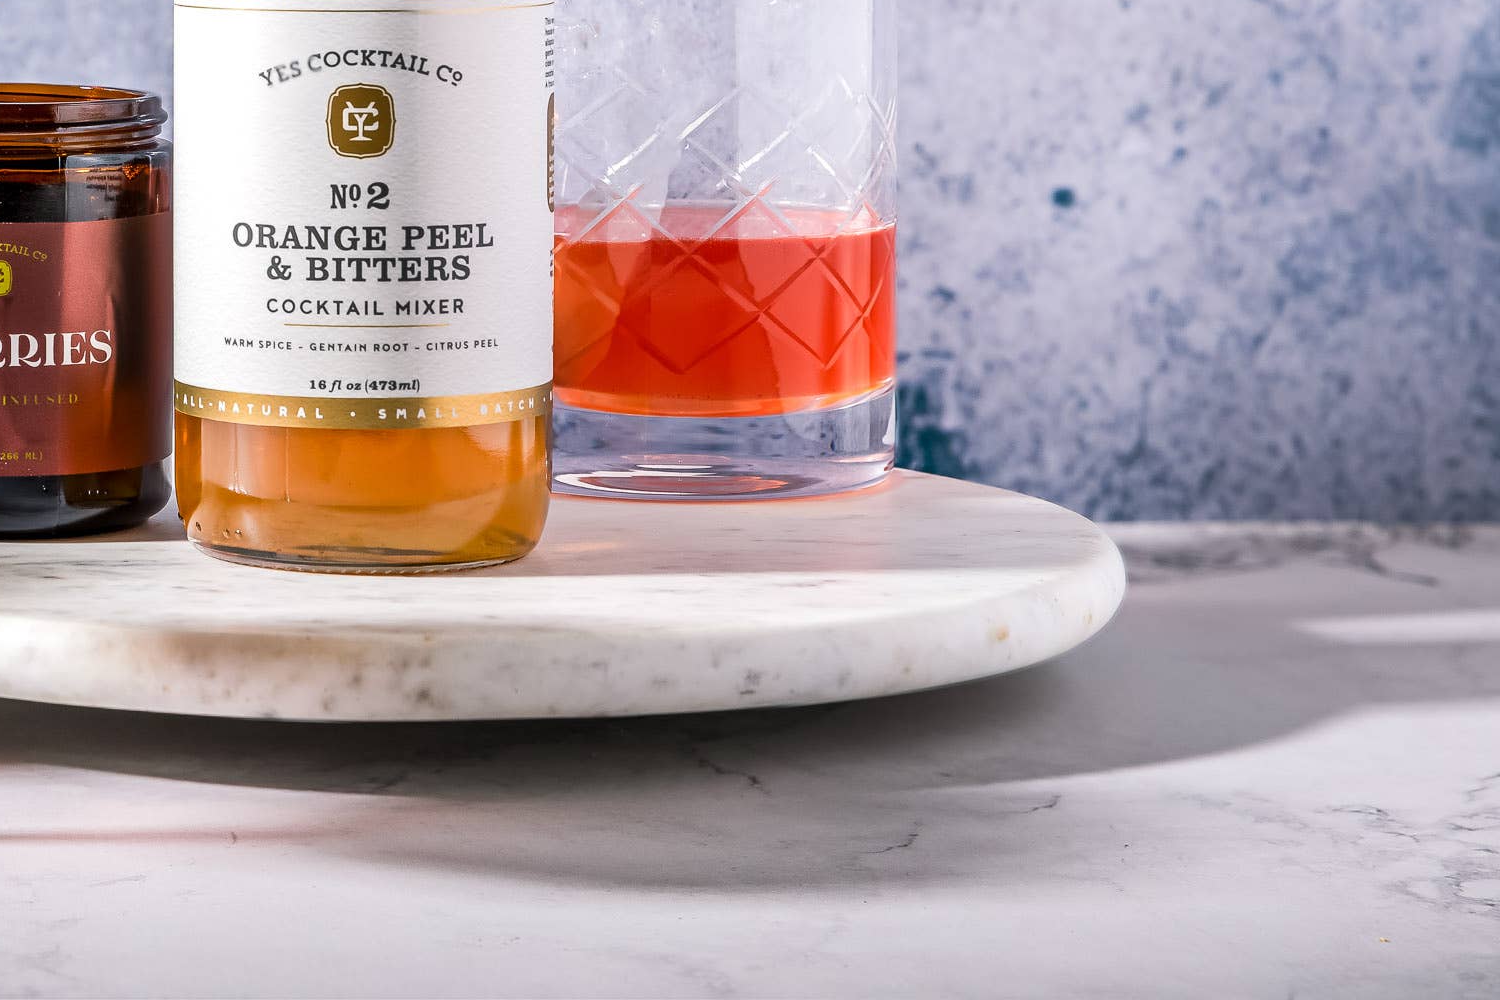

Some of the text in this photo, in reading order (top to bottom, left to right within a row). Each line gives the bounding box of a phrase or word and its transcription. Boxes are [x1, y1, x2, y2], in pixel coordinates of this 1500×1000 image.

[259, 61, 302, 86] YES
[307, 50, 430, 76] COCKTAIL
[366, 181, 390, 210] 2
[232, 222, 494, 251] ORANGE PEEL
[266, 254, 471, 282] & BITTERS
[266, 298, 464, 316] COCKTAIL MIXER
[224, 337, 499, 352] WARM SPICE GENTAIN ROOT CITRUS PEEL
[2, 393, 78, 406] INFUSED
[309, 379, 420, 393] 16 fl oz (473ml)
[183, 393, 534, 420] ALL-NATURAL SMALL BATCH
